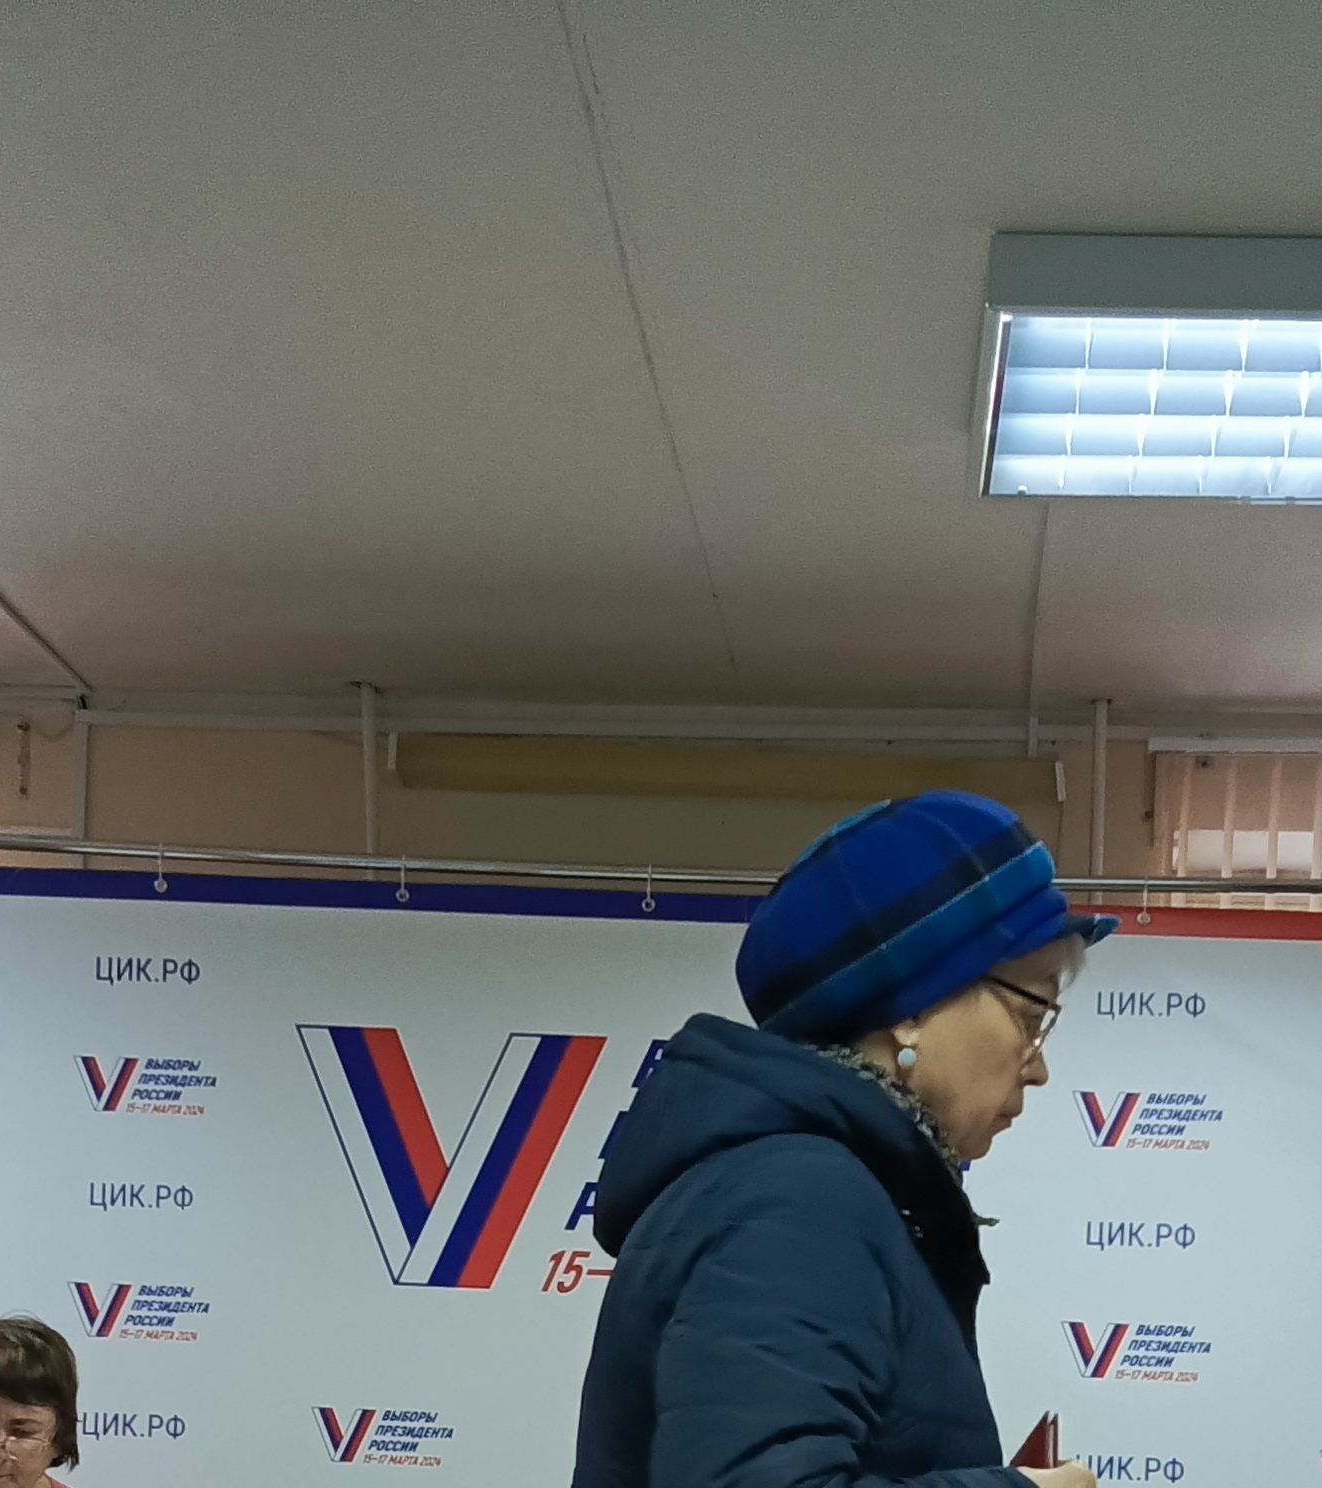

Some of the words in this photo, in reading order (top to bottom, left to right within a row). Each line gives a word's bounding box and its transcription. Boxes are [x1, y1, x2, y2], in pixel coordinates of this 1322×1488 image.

[96, 956, 201, 984] ЦИК.РФ
[1097, 991, 1206, 1020] ЦИК.РФ
[144, 1058, 201, 1071] ВЫБОРЫ
[137, 1073, 217, 1088] ПРЕЗИДЕНТА
[131, 1088, 182, 1101] РОССИИ
[1146, 1093, 1206, 1106] ВЫБОРЫ
[1139, 1108, 1223, 1123] ПРЕЗИДЕНТА
[1132, 1123, 1186, 1136] РОССИИ
[90, 1183, 194, 1211] ЦИК.РФ
[1086, 1221, 1196, 1251] ЦИК.РФ
[138, 1285, 194, 1298] ВЫБОРЫ
[131, 1299, 210, 1314] ПРЕЗИДЕНТА
[125, 1315, 175, 1327] РОССИИ
[1135, 1324, 1195, 1337] ВЫБОРЫ
[1128, 1339, 1211, 1354] ПРЕЗИДЕНТА
[1120, 1354, 1175, 1367] РОССИИ
[382, 1410, 438, 1423] ВЫБОРЫ
[82, 1412, 186, 1440] ЦИК.РФ
[375, 1425, 454, 1439] ПРЕЗИДЕНТА
[368, 1440, 419, 1452] РОССИИ
